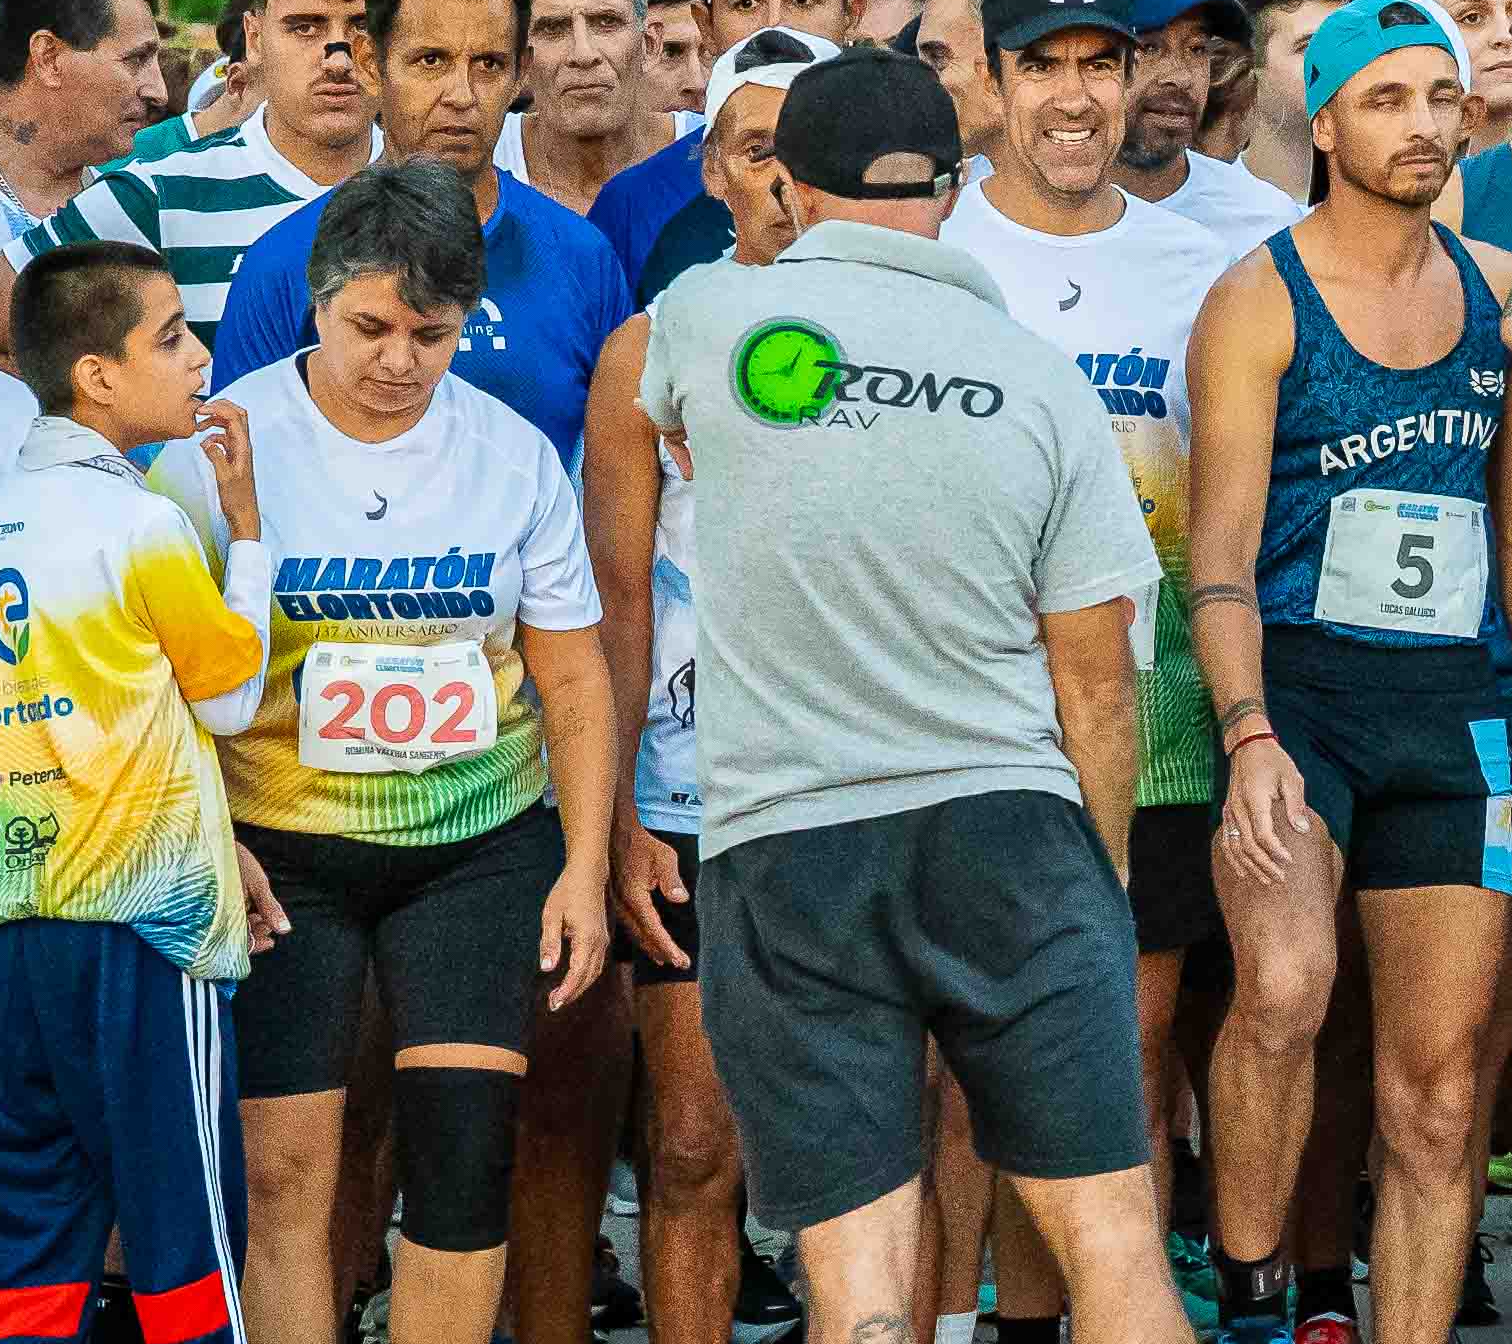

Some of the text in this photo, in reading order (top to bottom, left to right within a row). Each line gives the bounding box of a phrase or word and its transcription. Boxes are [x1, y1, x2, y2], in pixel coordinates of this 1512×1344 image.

[273, 546, 497, 592] MARATÓN
[1389, 533, 1437, 600] 5
[275, 590, 496, 621] ELORTONDO
[344, 623, 459, 638] ANIVERSARIO
[318, 680, 477, 744] 202
